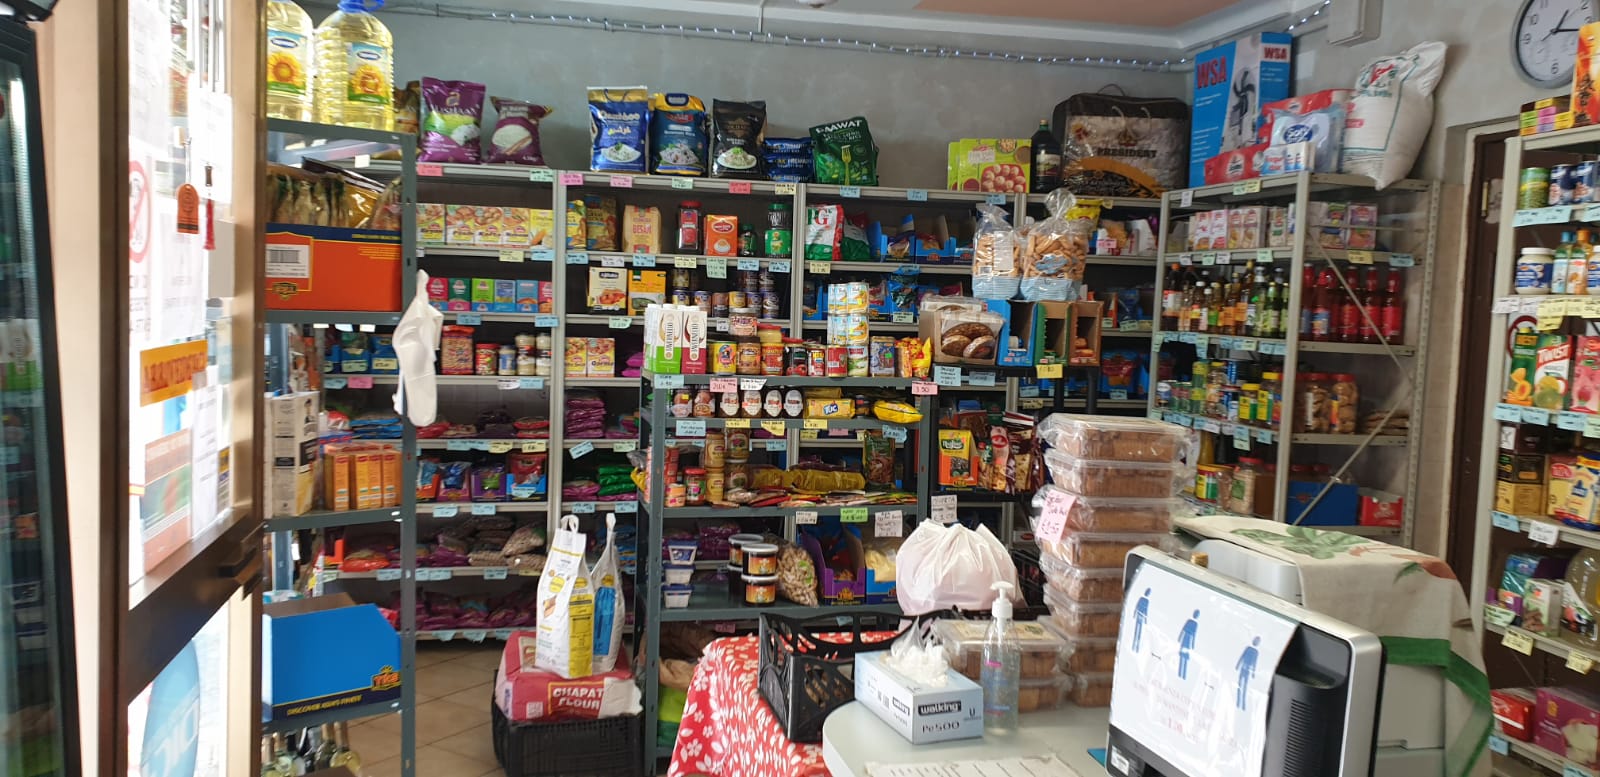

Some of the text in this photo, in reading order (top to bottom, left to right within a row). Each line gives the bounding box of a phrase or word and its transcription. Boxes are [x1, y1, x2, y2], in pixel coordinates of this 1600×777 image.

[1523, 33, 1531, 44] 9
[1263, 46, 1287, 59] WSA
[1197, 55, 1227, 89] WSA
[1550, 62, 1559, 75] 6
[1097, 147, 1157, 159] PRESIDENT
[824, 404, 838, 415] TUC
[553, 688, 605, 698] CHAPAT
[559, 698, 600, 709] FLOUR
[920, 703, 960, 715] walking
